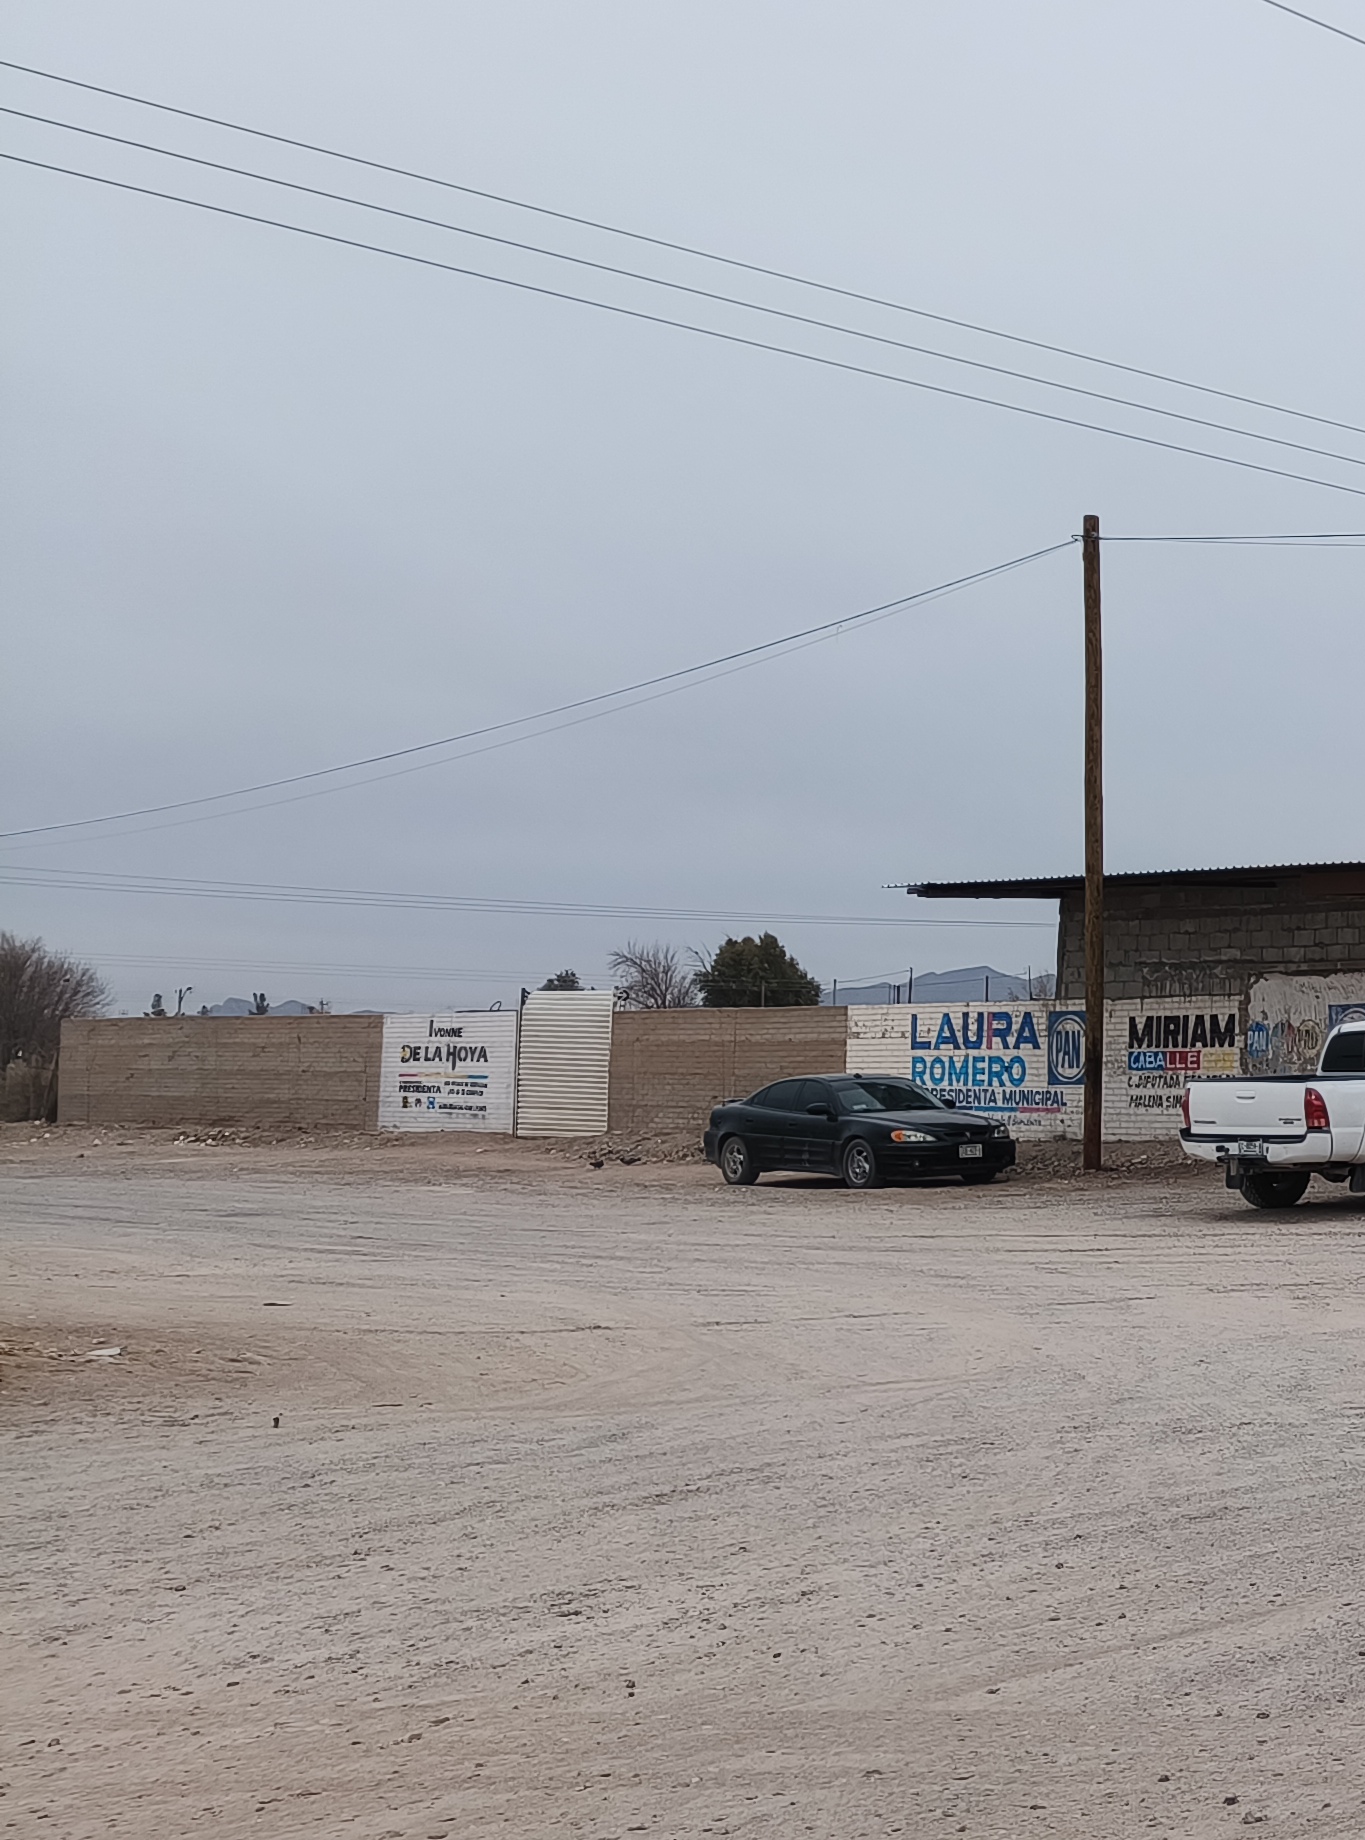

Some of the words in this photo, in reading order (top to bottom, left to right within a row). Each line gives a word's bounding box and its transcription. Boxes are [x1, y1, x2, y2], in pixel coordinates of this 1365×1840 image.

[428, 1019, 464, 1038] IVONNE
[910, 1011, 1042, 1050] LAURA
[1127, 1013, 1236, 1049] MIRIAM
[401, 1044, 422, 1063] DE
[424, 1045, 442, 1062] LA
[446, 1043, 488, 1071] HOYA
[1055, 1030, 1081, 1069] PAN
[911, 1056, 1027, 1087] ROMERO
